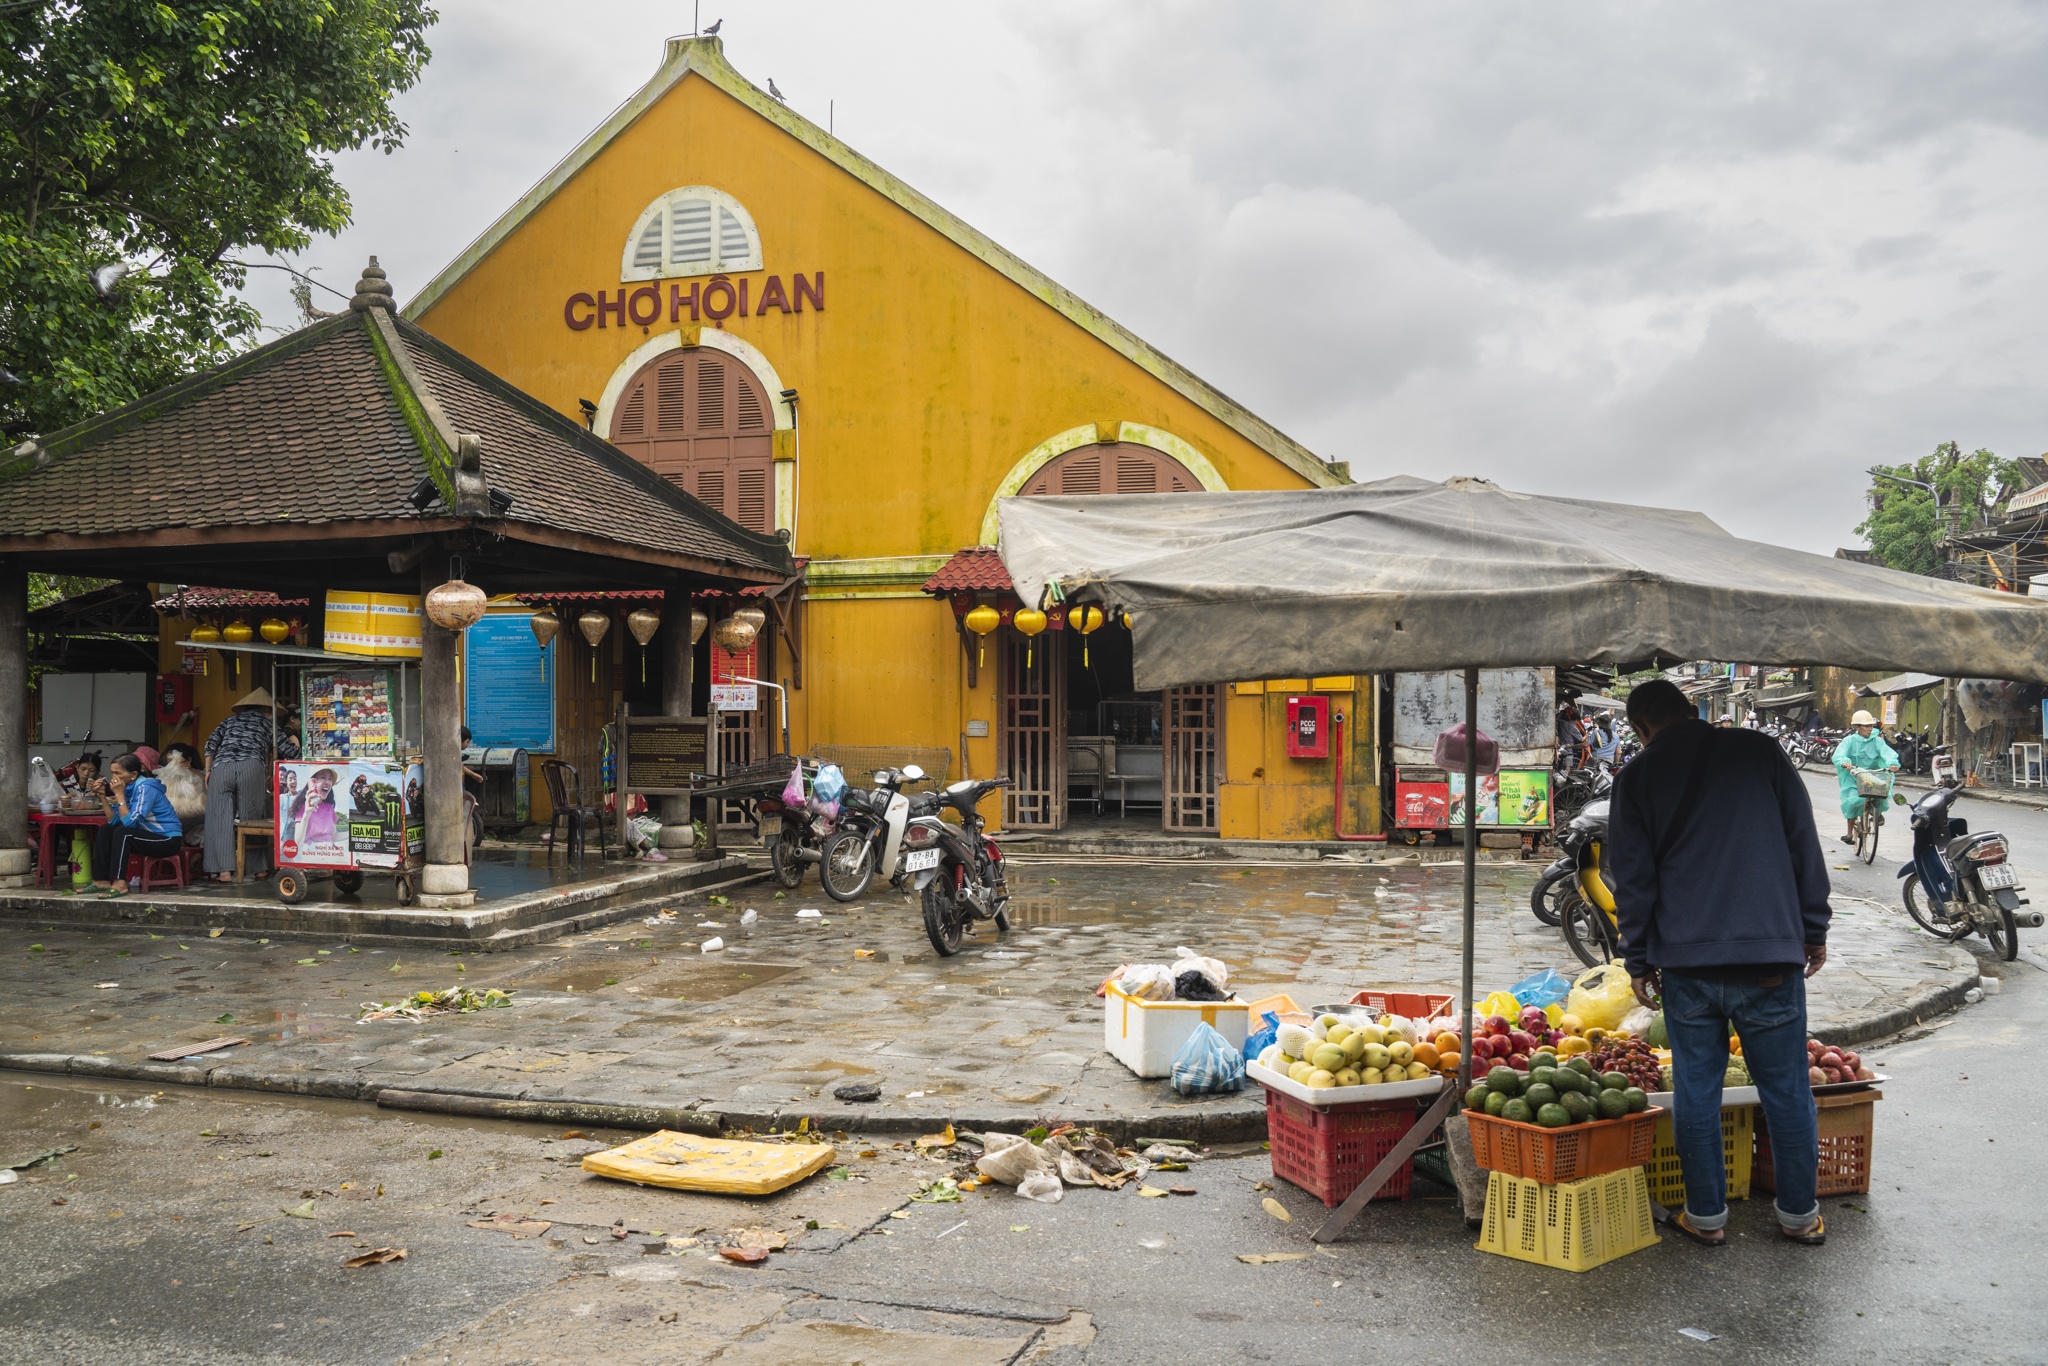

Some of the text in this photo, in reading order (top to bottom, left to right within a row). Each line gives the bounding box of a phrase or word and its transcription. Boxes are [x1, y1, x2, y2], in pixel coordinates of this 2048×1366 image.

[564, 271, 824, 334] CHỢ HỘI AN
[1988, 875, 2014, 887] 7686
